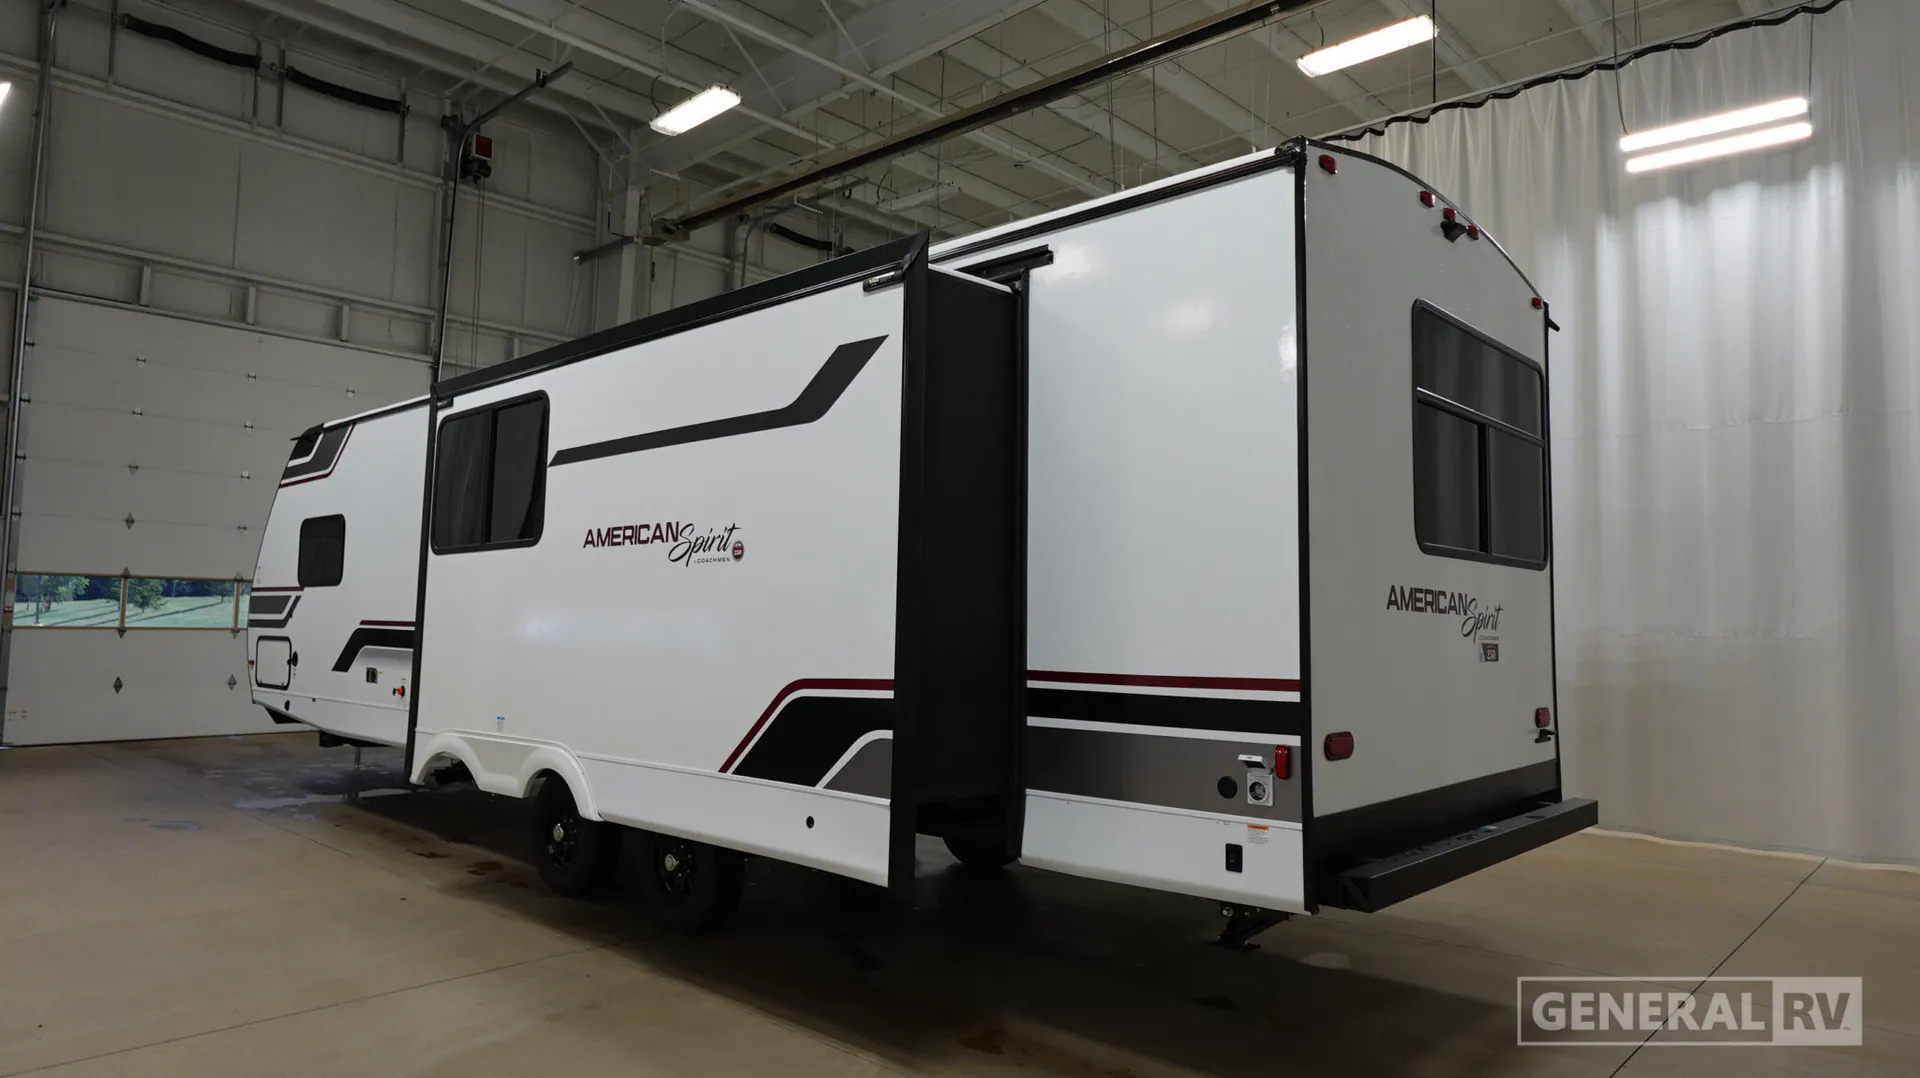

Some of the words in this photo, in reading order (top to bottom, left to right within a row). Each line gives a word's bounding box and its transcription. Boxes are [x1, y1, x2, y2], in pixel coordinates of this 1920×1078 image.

[583, 521, 679, 548] AMERICAN
[668, 523, 742, 567] Spirit
[1386, 585, 1467, 616] AMERICAN
[1461, 598, 1504, 644] Spirit
